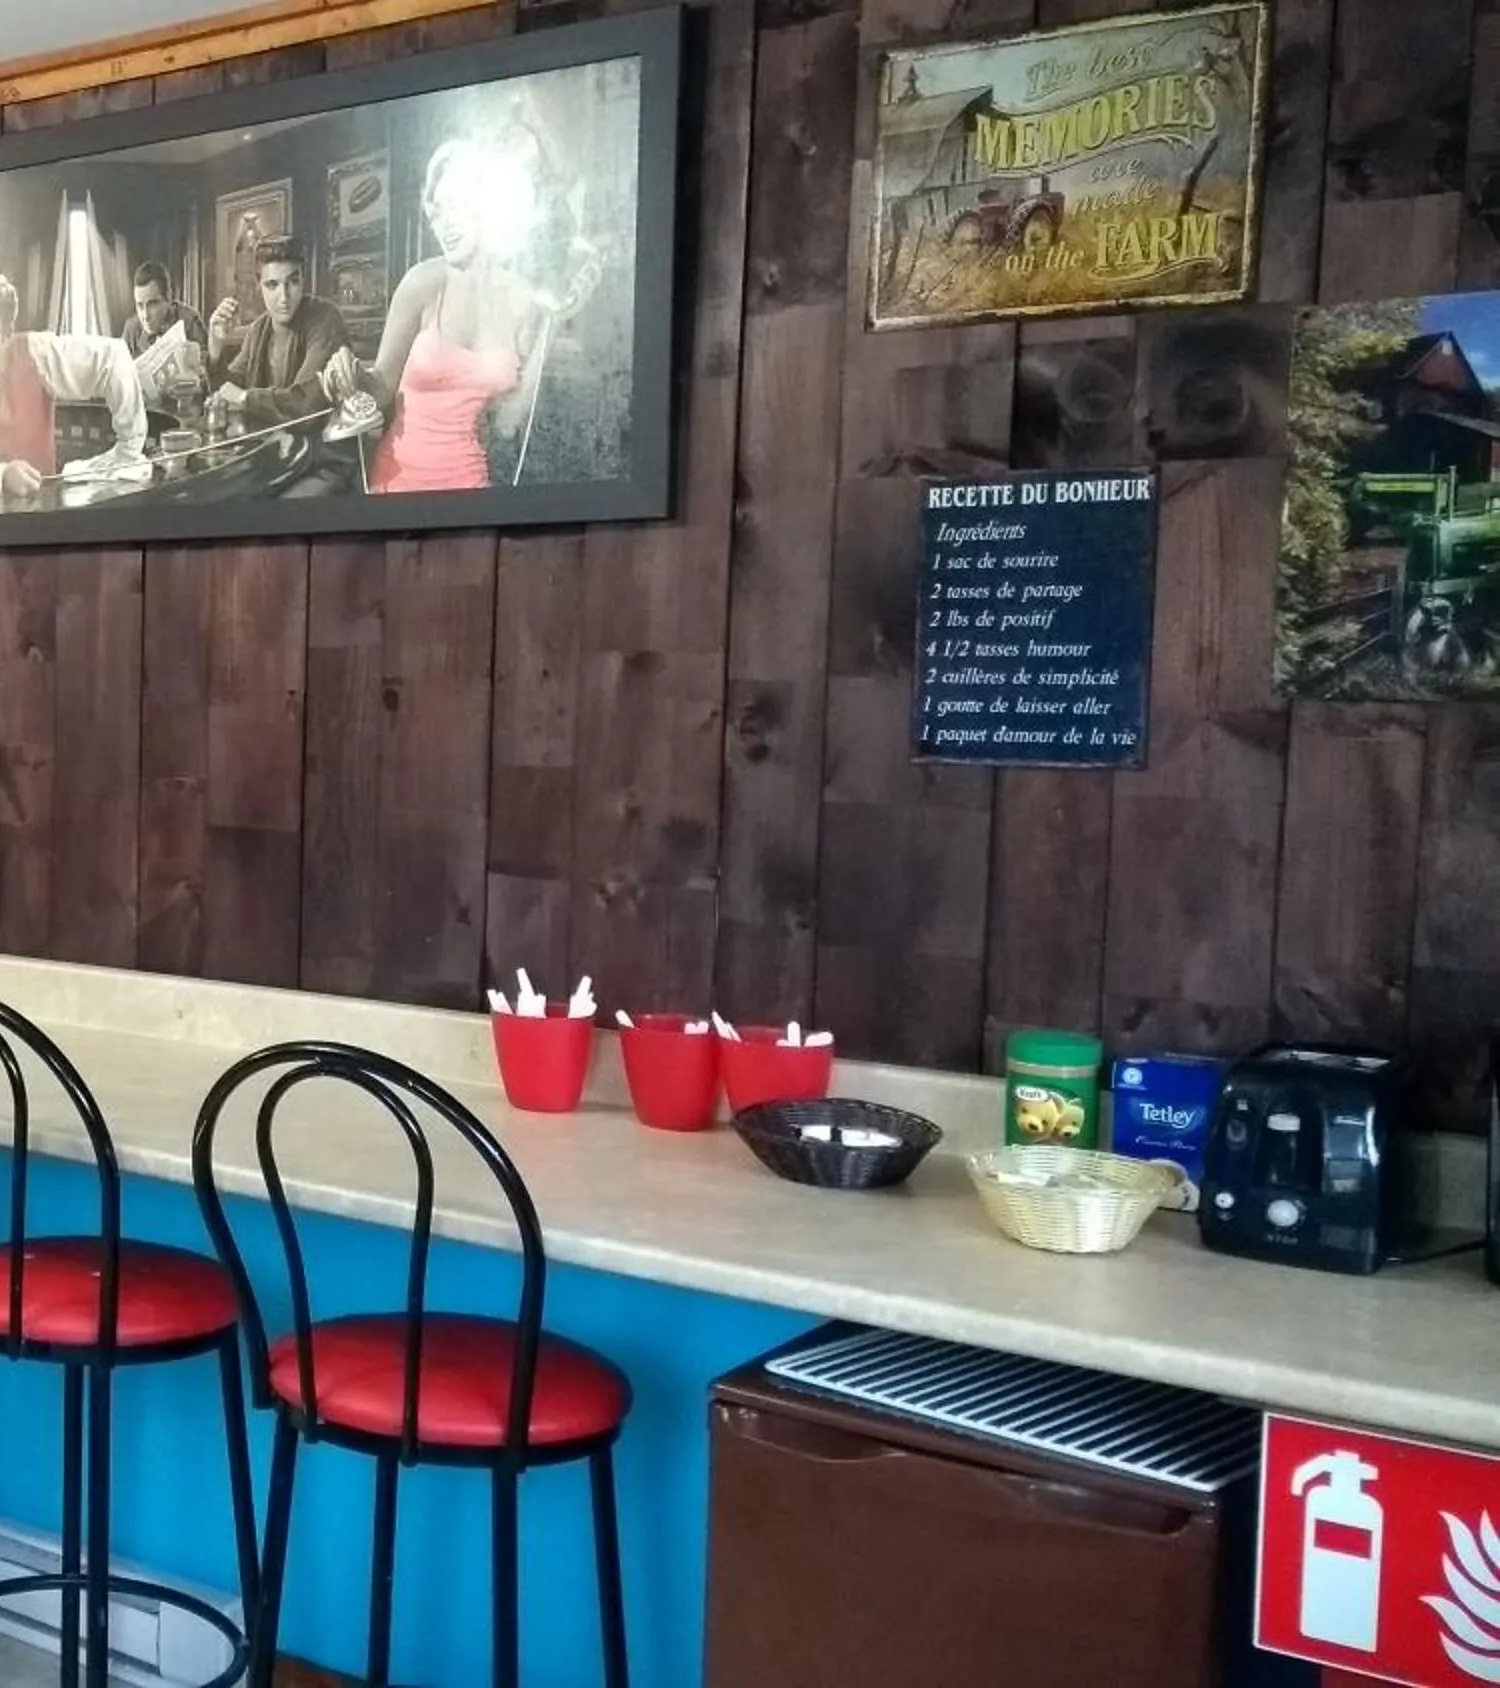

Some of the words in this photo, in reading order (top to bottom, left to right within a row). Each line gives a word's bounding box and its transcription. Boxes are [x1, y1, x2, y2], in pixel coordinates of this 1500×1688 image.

[1026, 57, 1077, 98] The
[975, 73, 1219, 169] MEMORIES
[1072, 174, 1158, 216] made
[1005, 252, 1037, 276] on
[1045, 240, 1086, 270] the
[1095, 213, 1221, 272] FARM
[928, 485, 1013, 508] RECETTE
[1021, 484, 1048, 505] DU
[1055, 480, 1150, 502] BONHEUR
[936, 521, 1027, 547] Ingrédients
[932, 553, 941, 570] 1
[947, 557, 971, 569] sac
[977, 552, 997, 569] de
[1001, 551, 1059, 568] sourire
[930, 583, 941, 599] 2
[947, 585, 990, 599] tasses
[997, 581, 1015, 598] de
[1021, 584, 1083, 603] partage
[929, 611, 941, 627] 2
[947, 610, 969, 627] lbs
[976, 610, 995, 627] de
[1000, 609, 1056, 631] positif
[926, 641, 936, 656] 4
[943, 640, 970, 660] 1/2
[975, 642, 1020, 657] tasses
[1027, 640, 1091, 657] humour
[924, 669, 937, 684] 2
[942, 667, 1005, 685] cuillères
[1012, 667, 1032, 685] de
[1038, 668, 1120, 689] simplicité
[923, 697, 931, 712] 1
[937, 698, 984, 717] goutte
[990, 697, 1008, 713] de
[1015, 697, 1067, 714] laisser
[1073, 697, 1112, 715] aller
[921, 724, 930, 740] 1
[935, 727, 987, 745] paquet
[1063, 726, 1083, 744] de
[1090, 726, 1105, 745] la
[1112, 728, 1138, 745] vie
[1139, 1102, 1197, 1130] Tetley
